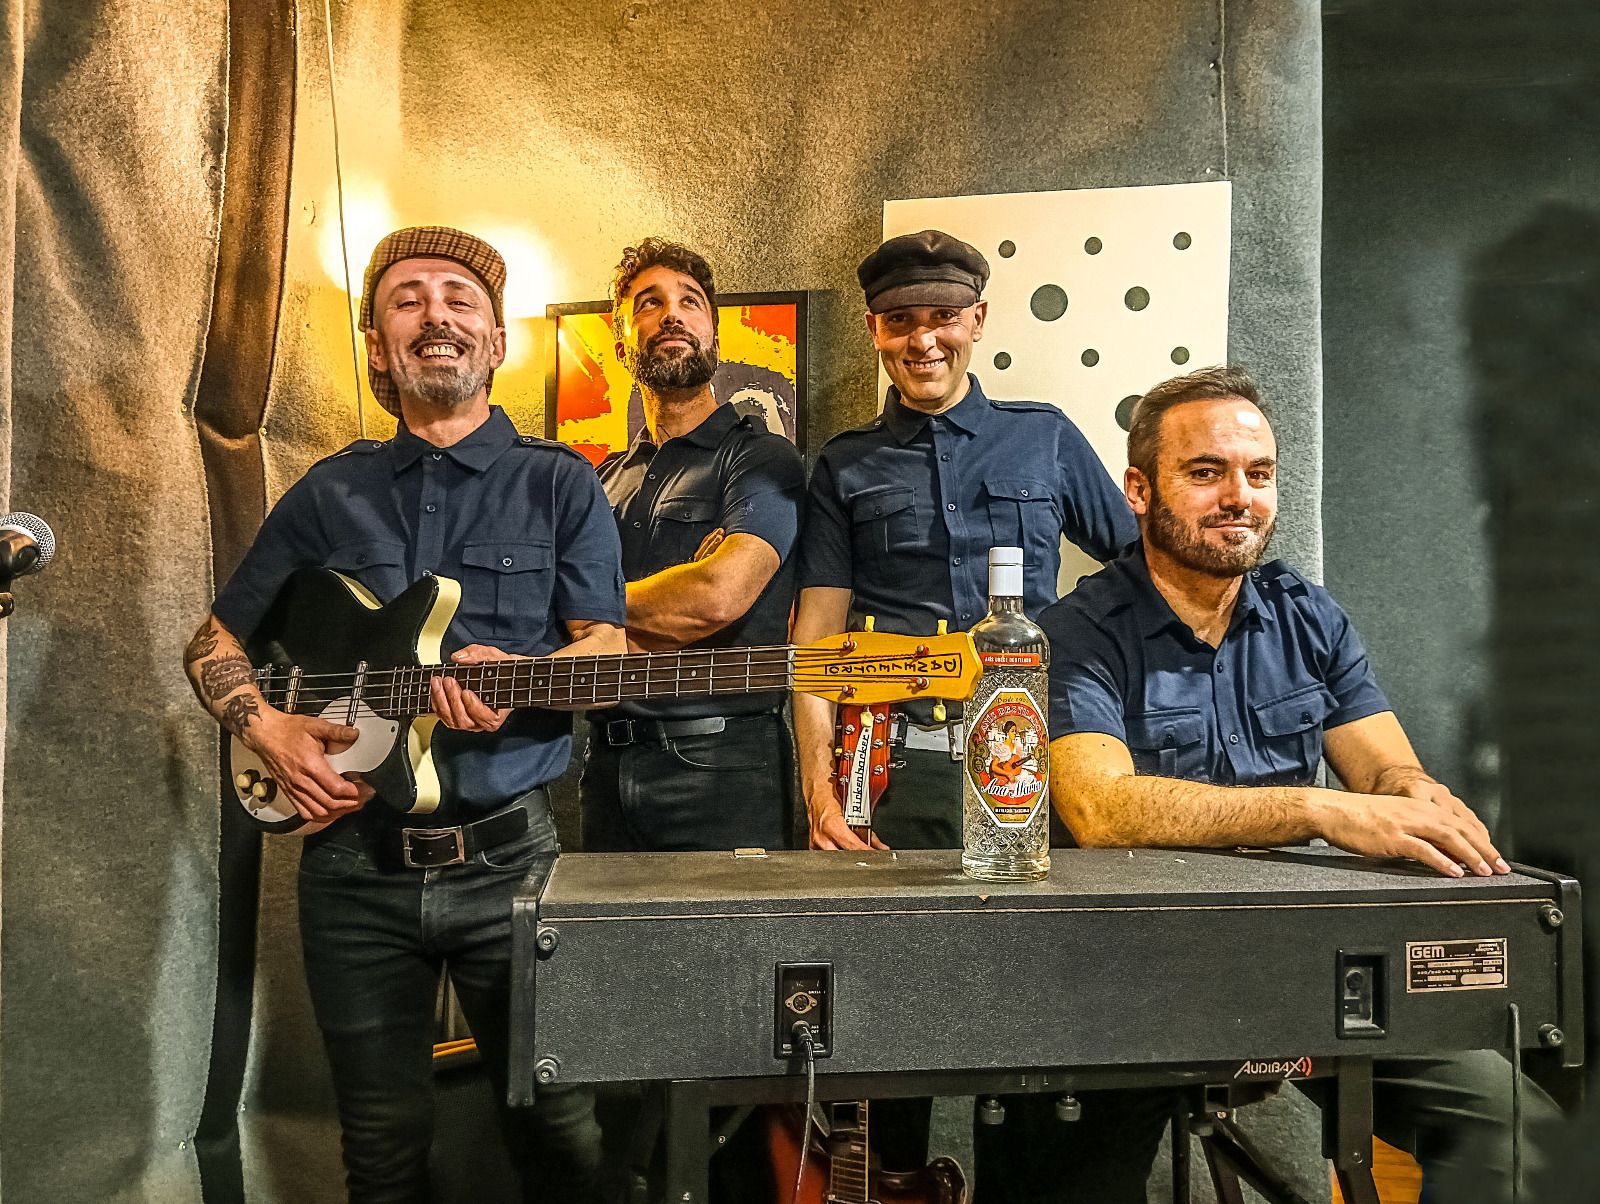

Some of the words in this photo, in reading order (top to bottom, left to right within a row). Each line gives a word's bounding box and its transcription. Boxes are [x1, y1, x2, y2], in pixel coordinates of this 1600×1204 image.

[828, 657, 957, 676] DANELECTRO
[852, 734, 870, 814] Rickenbacker
[981, 777, 1009, 796] Ana
[1411, 945, 1445, 959] GEM
[1233, 1056, 1304, 1079] AUDIBAX
